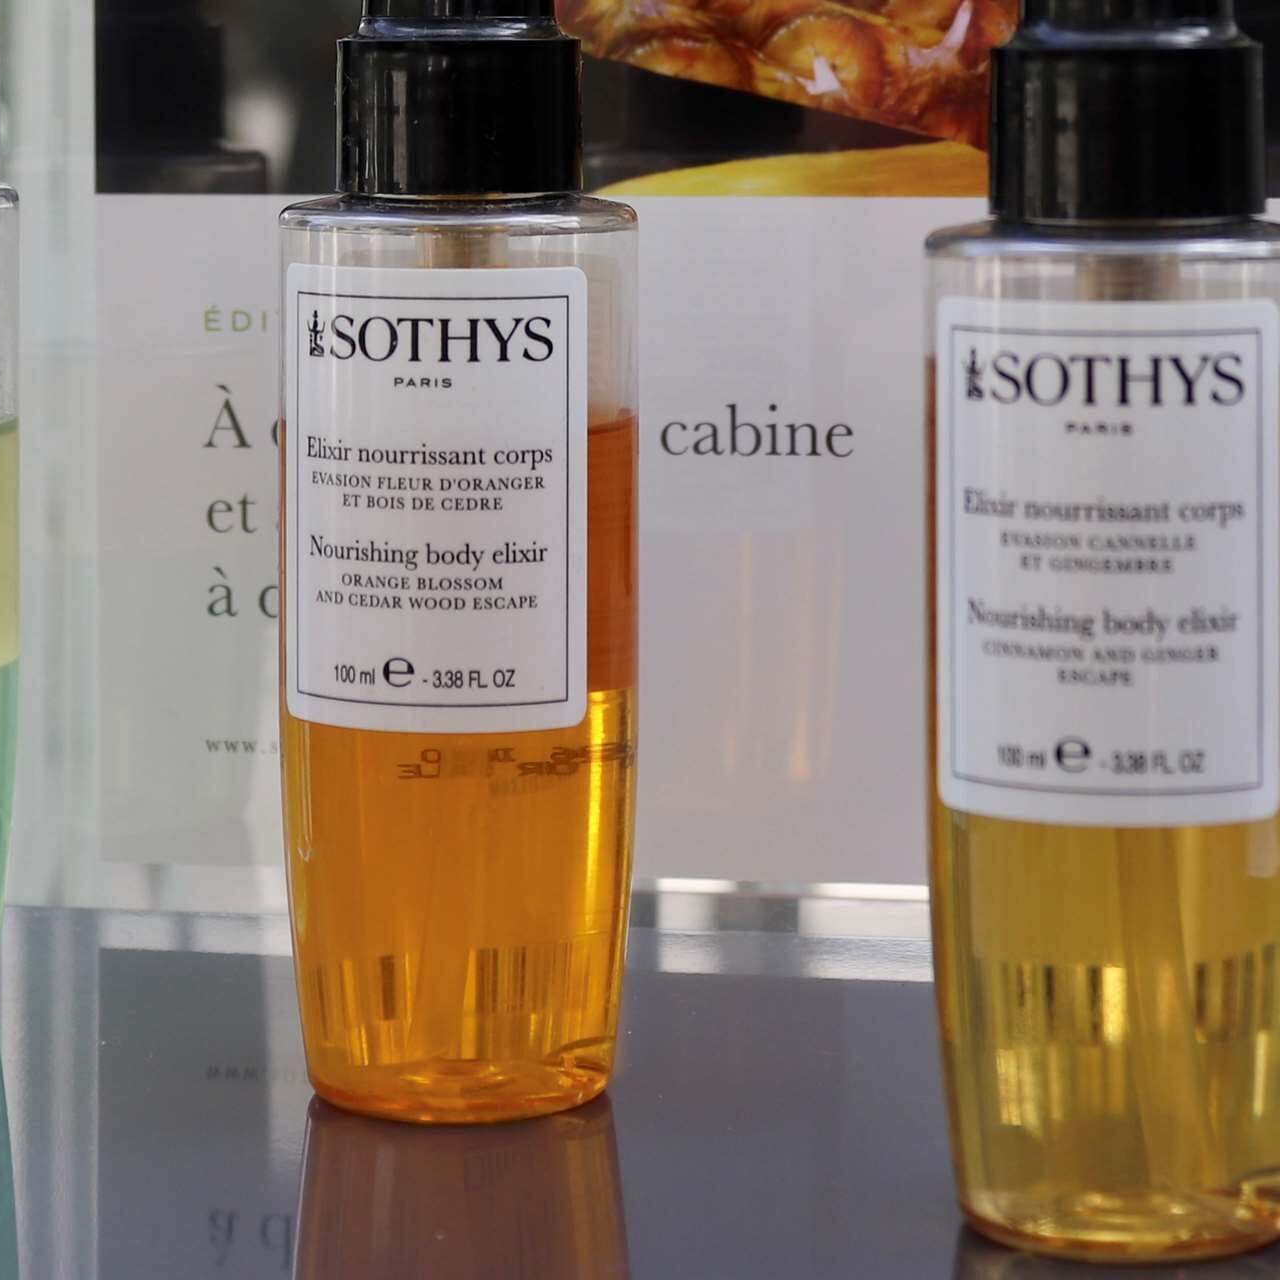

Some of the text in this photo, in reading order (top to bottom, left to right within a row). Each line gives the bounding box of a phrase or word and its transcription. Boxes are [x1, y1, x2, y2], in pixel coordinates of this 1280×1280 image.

[329, 315, 554, 363] SOTHYS
[393, 377, 453, 389] PARIS
[990, 351, 1245, 406] SOTHYS
[202, 383, 253, 448] À
[659, 404, 856, 458] cabine
[1066, 423, 1134, 437] PARIS
[306, 436, 553, 470] Elixir nourrissant corps
[311, 471, 546, 492] EVASION FLEUR D'ORANGER
[206, 493, 256, 534] et
[342, 493, 503, 511] ET BOIS DE CEDRE
[963, 487, 1245, 528] Elixir nourrissant corps
[309, 535, 548, 571] Nourishing body elixir
[1089, 534, 1196, 550] CANNELLE
[1020, 556, 1174, 574] ET GINGEMBRE
[207, 566, 239, 618] à
[340, 573, 503, 591] ORANGE BLOSSOM
[315, 590, 538, 610] AND CEDAR WOOD ESCAPE
[968, 598, 1238, 642] Nourishing body elixir
[1093, 646, 1135, 663] AND
[1141, 646, 1219, 663] GINGER
[334, 664, 356, 683] 100
[360, 667, 375, 685] ml
[432, 669, 464, 688] 3.38
[493, 669, 515, 688] OZ
[1058, 670, 1134, 686] ESCAPE
